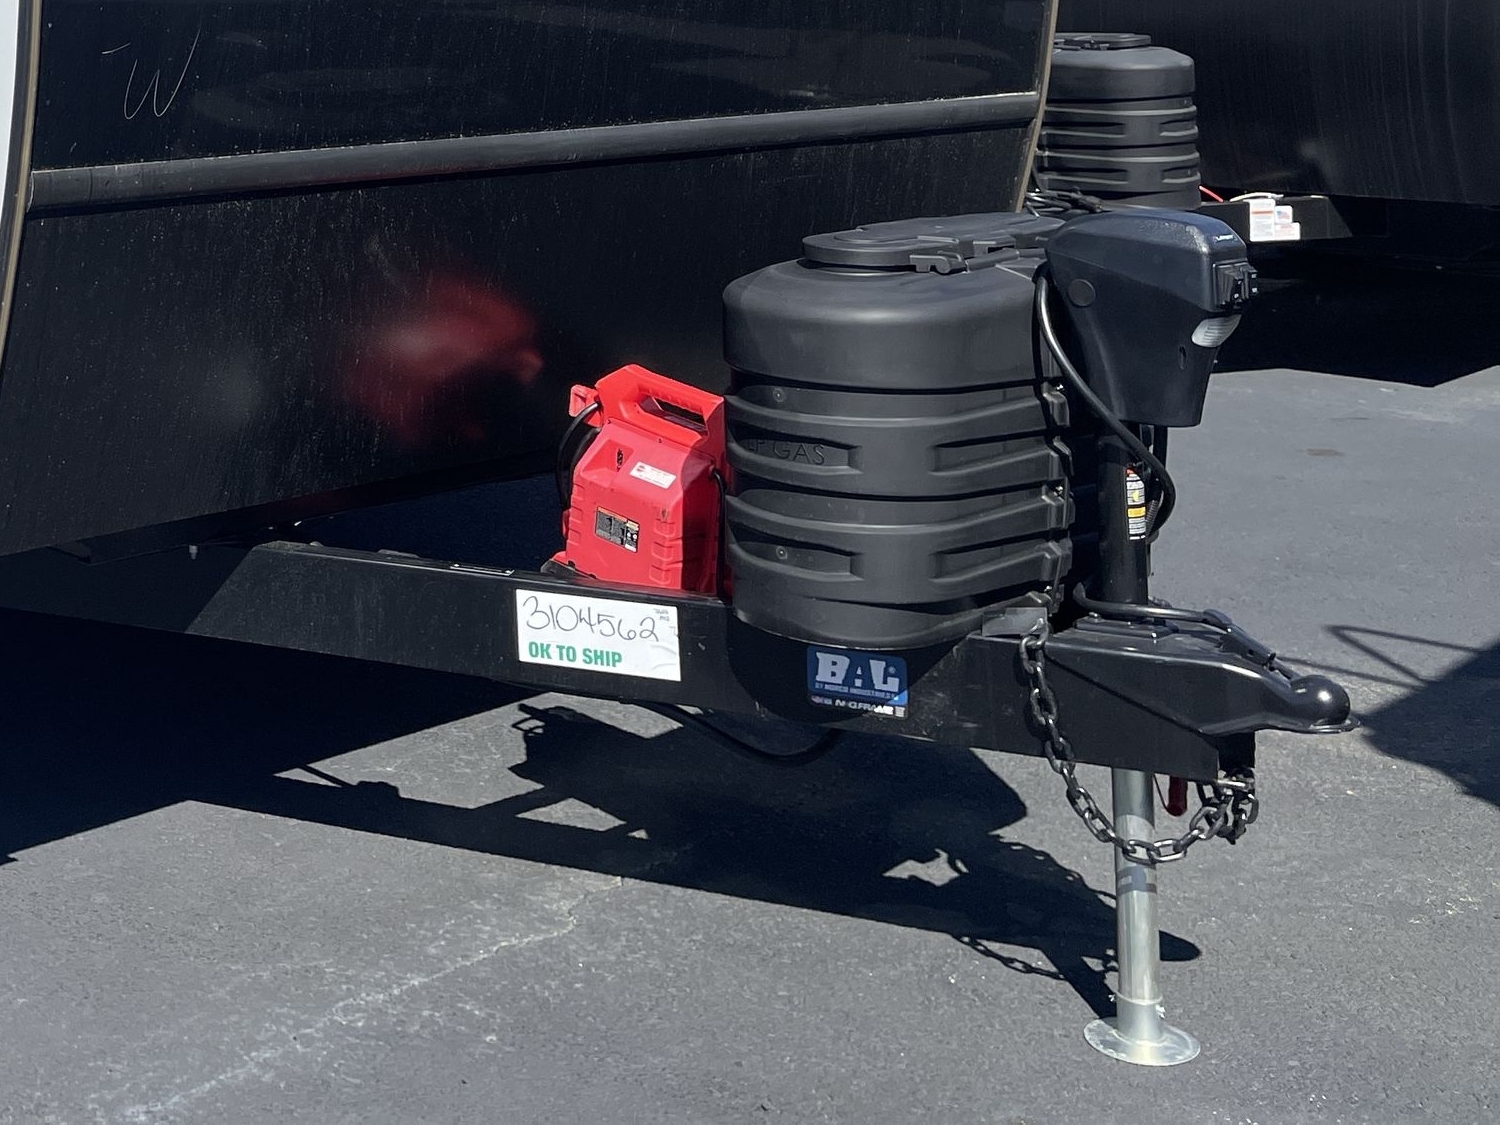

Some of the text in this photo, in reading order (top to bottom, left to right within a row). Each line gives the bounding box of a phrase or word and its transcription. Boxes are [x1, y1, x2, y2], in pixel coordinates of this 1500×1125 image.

[773, 442, 826, 466] GAS
[522, 595, 660, 643] 3104562
[528, 641, 623, 668] OK TO SHIP
